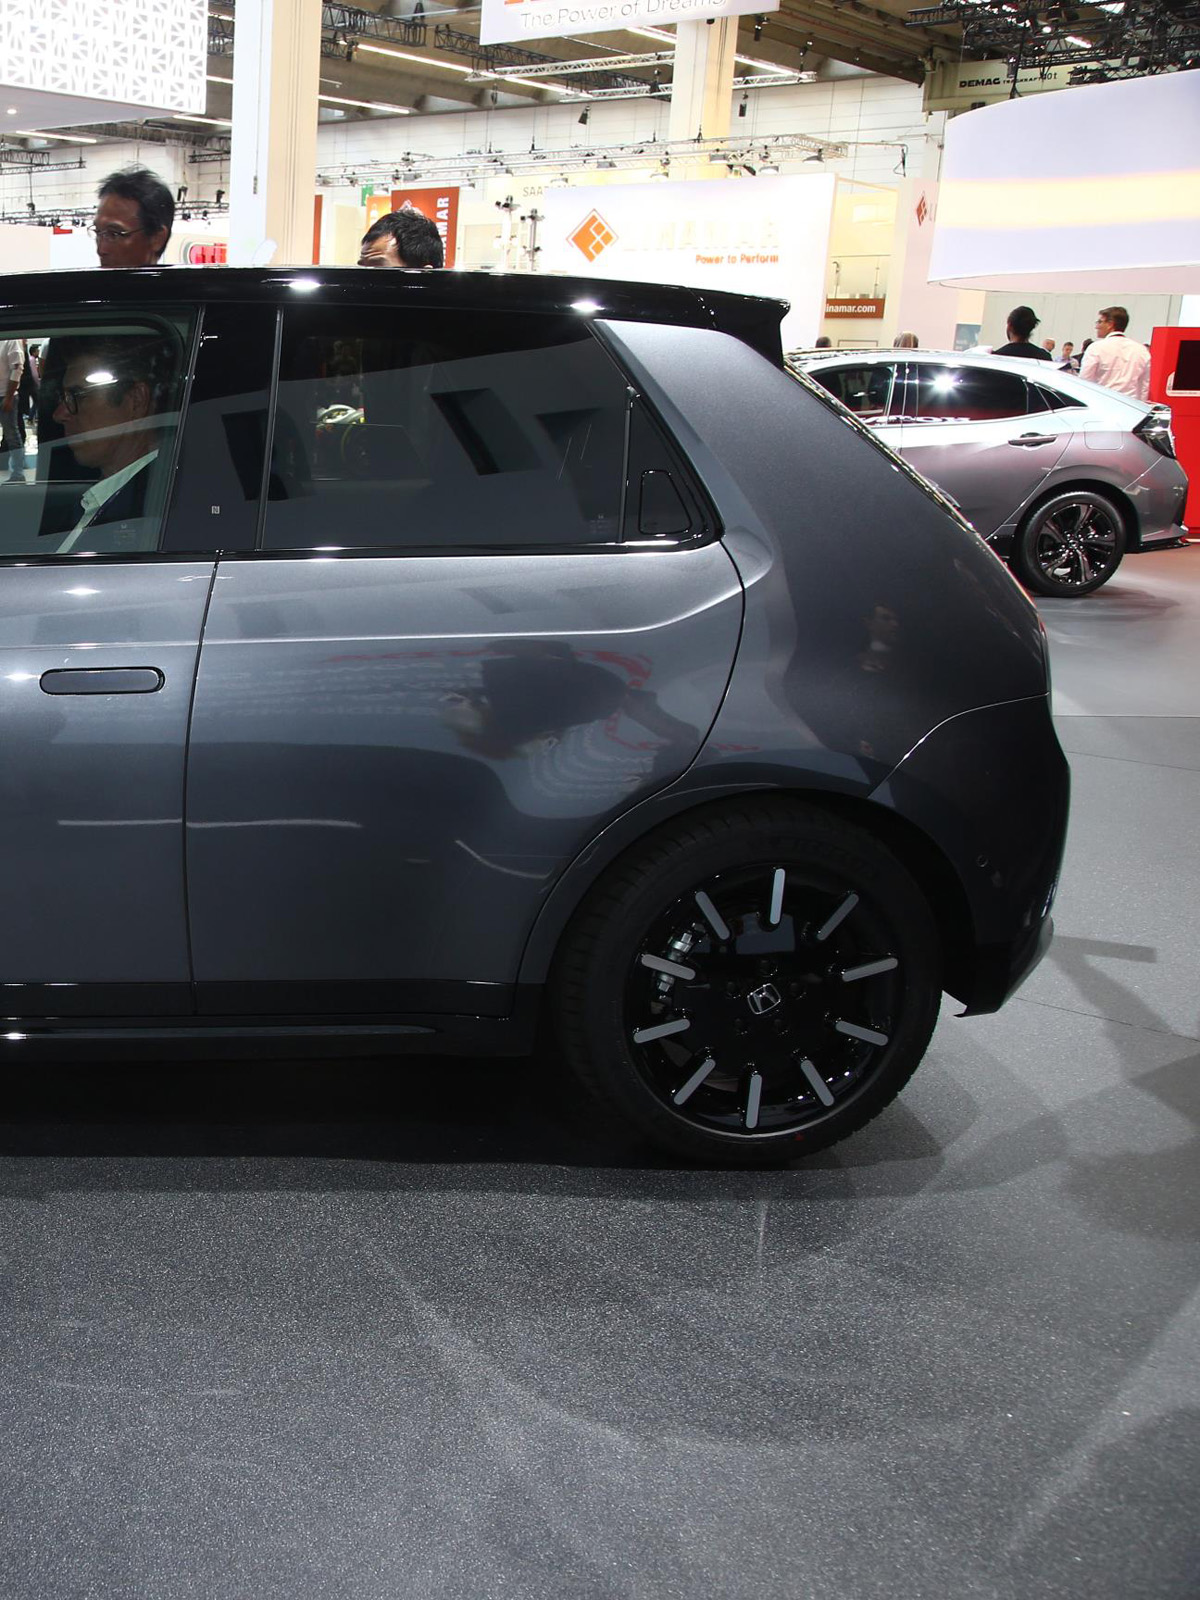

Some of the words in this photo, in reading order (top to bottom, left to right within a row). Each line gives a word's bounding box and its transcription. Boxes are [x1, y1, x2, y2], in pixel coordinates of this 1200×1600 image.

[520, 13, 553, 27] The
[558, 7, 618, 23] Power
[621, 1, 638, 15] of
[959, 78, 1000, 88] DEMAG
[696, 254, 724, 264] Power
[727, 254, 738, 264] to
[740, 252, 779, 264] Perform
